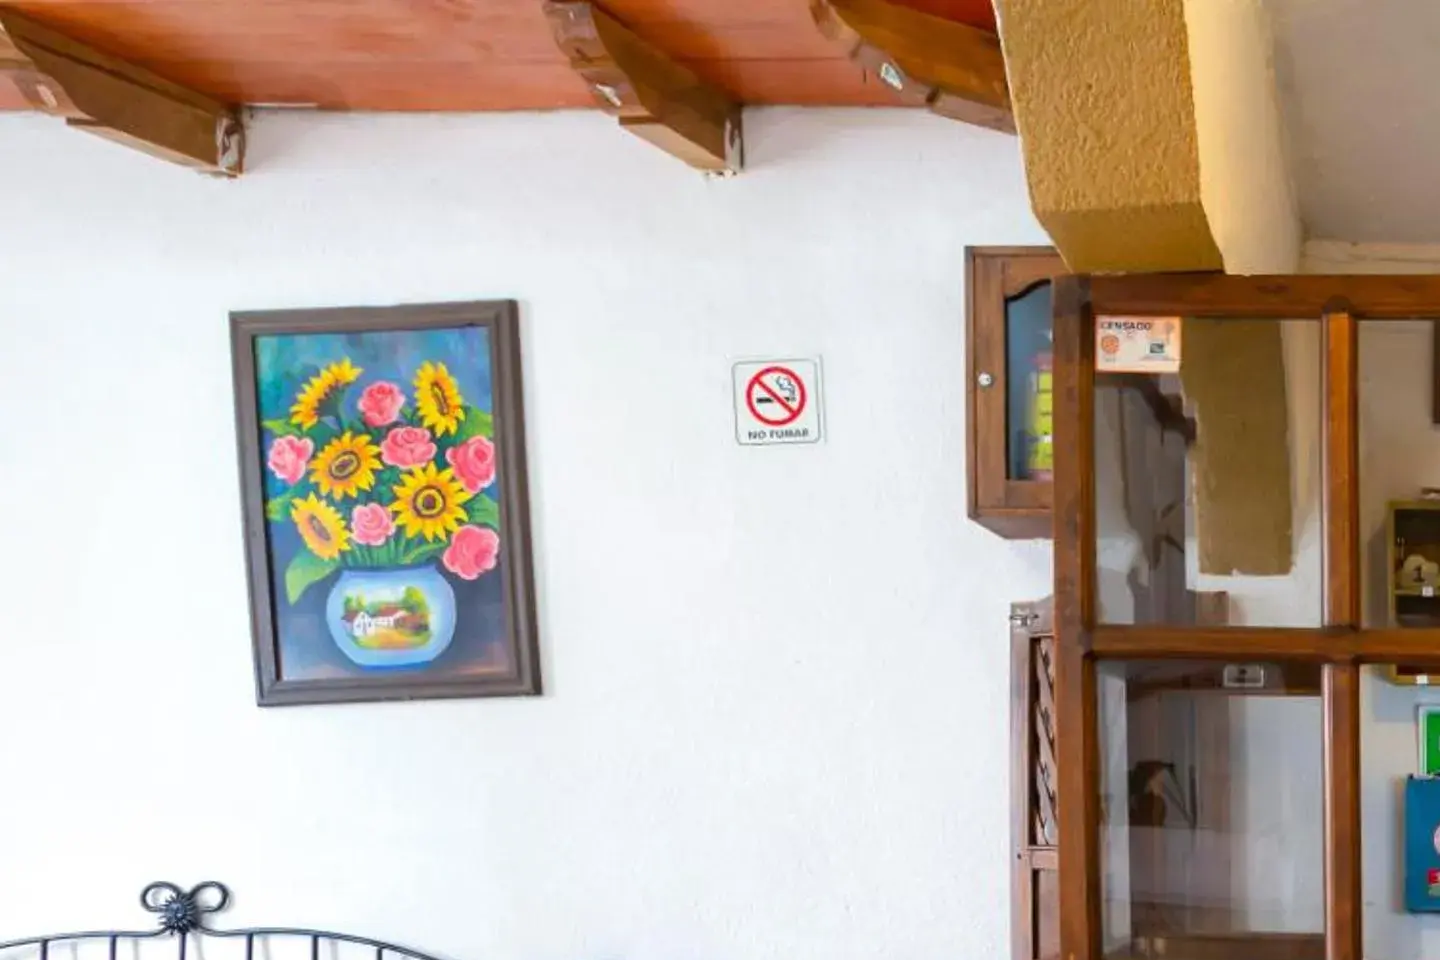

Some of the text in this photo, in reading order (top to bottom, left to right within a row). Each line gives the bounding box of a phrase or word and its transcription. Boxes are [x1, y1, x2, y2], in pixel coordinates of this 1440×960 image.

[748, 428, 809, 440] NO FUMAR
[1412, 565, 1425, 583] 1
